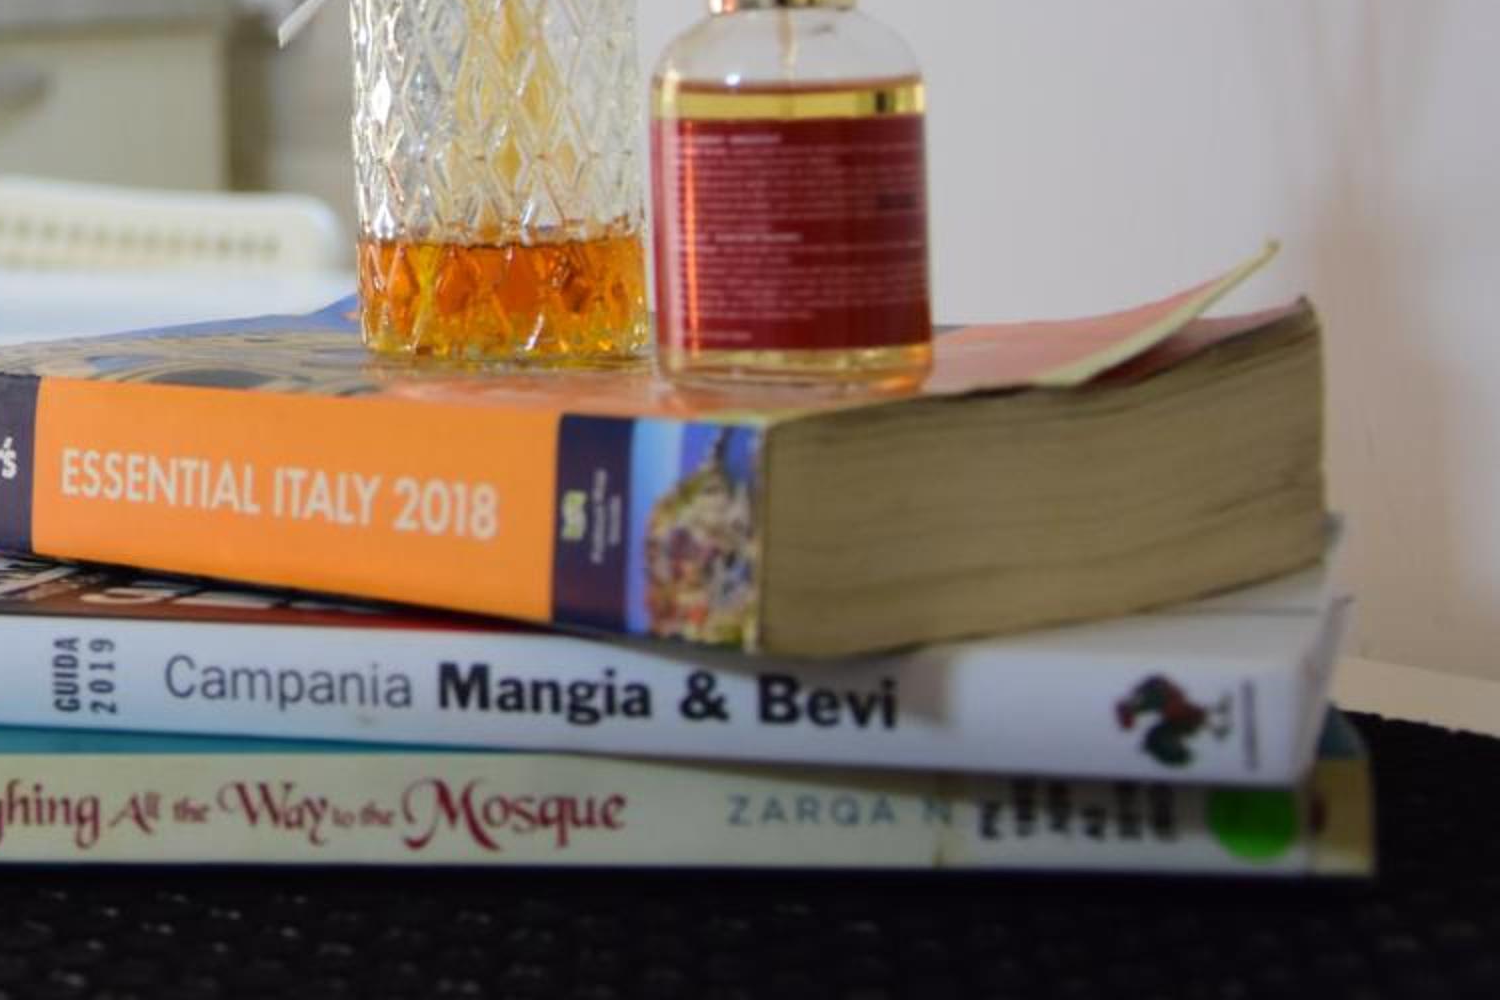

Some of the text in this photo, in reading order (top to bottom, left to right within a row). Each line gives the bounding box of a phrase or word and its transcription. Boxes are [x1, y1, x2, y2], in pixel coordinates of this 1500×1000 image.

[60, 447, 261, 515] ESSENTIAL
[273, 466, 383, 526] ITALY
[393, 476, 500, 541] 2018
[52, 636, 81, 713] GUIDA
[88, 637, 118, 714] 2019
[164, 653, 898, 730] Campania Mangia & Bevi
[172, 796, 210, 824] the
[216, 780, 329, 847] Way
[358, 801, 396, 828] the
[400, 776, 627, 851] Mosque
[726, 793, 898, 827] ZARQA
